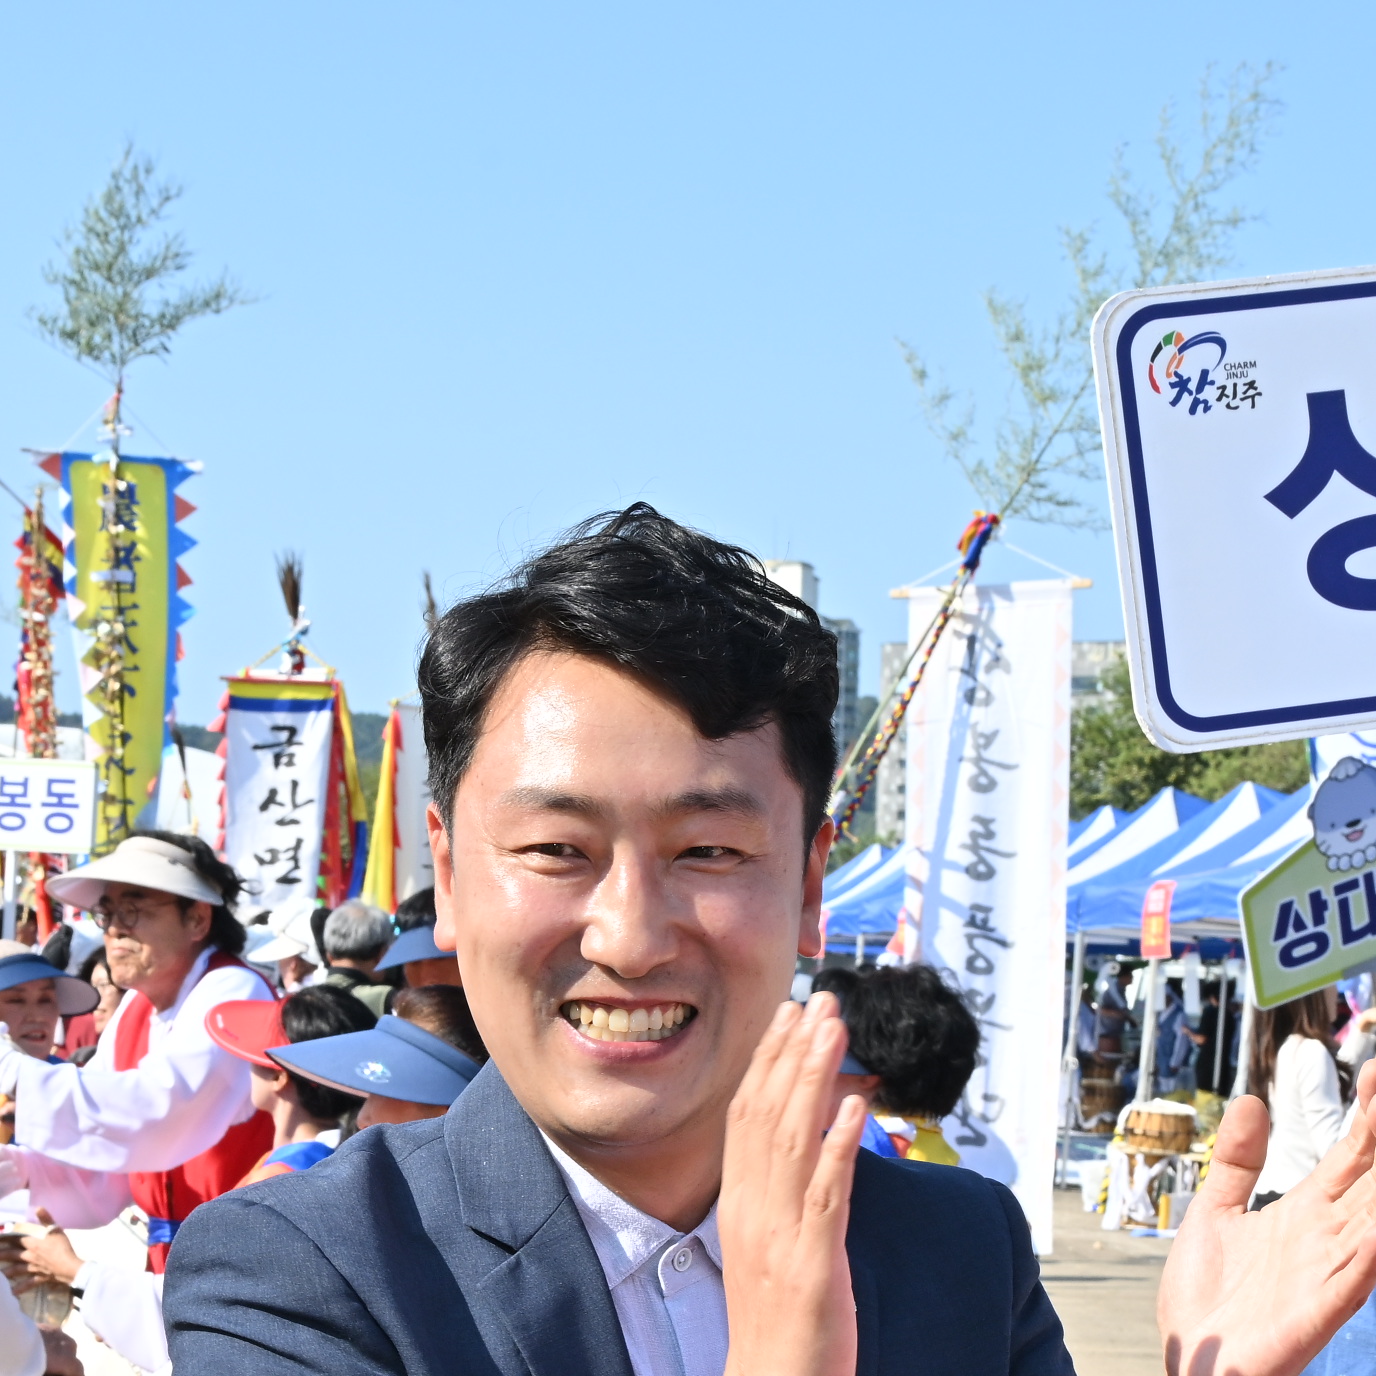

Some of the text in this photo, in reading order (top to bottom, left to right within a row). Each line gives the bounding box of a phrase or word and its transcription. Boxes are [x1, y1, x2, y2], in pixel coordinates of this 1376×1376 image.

[1223, 360, 1257, 372] CHARM
[1225, 370, 1249, 380] JINJU
[1168, 368, 1263, 416] 참 진주
[252, 723, 314, 885] 금산면
